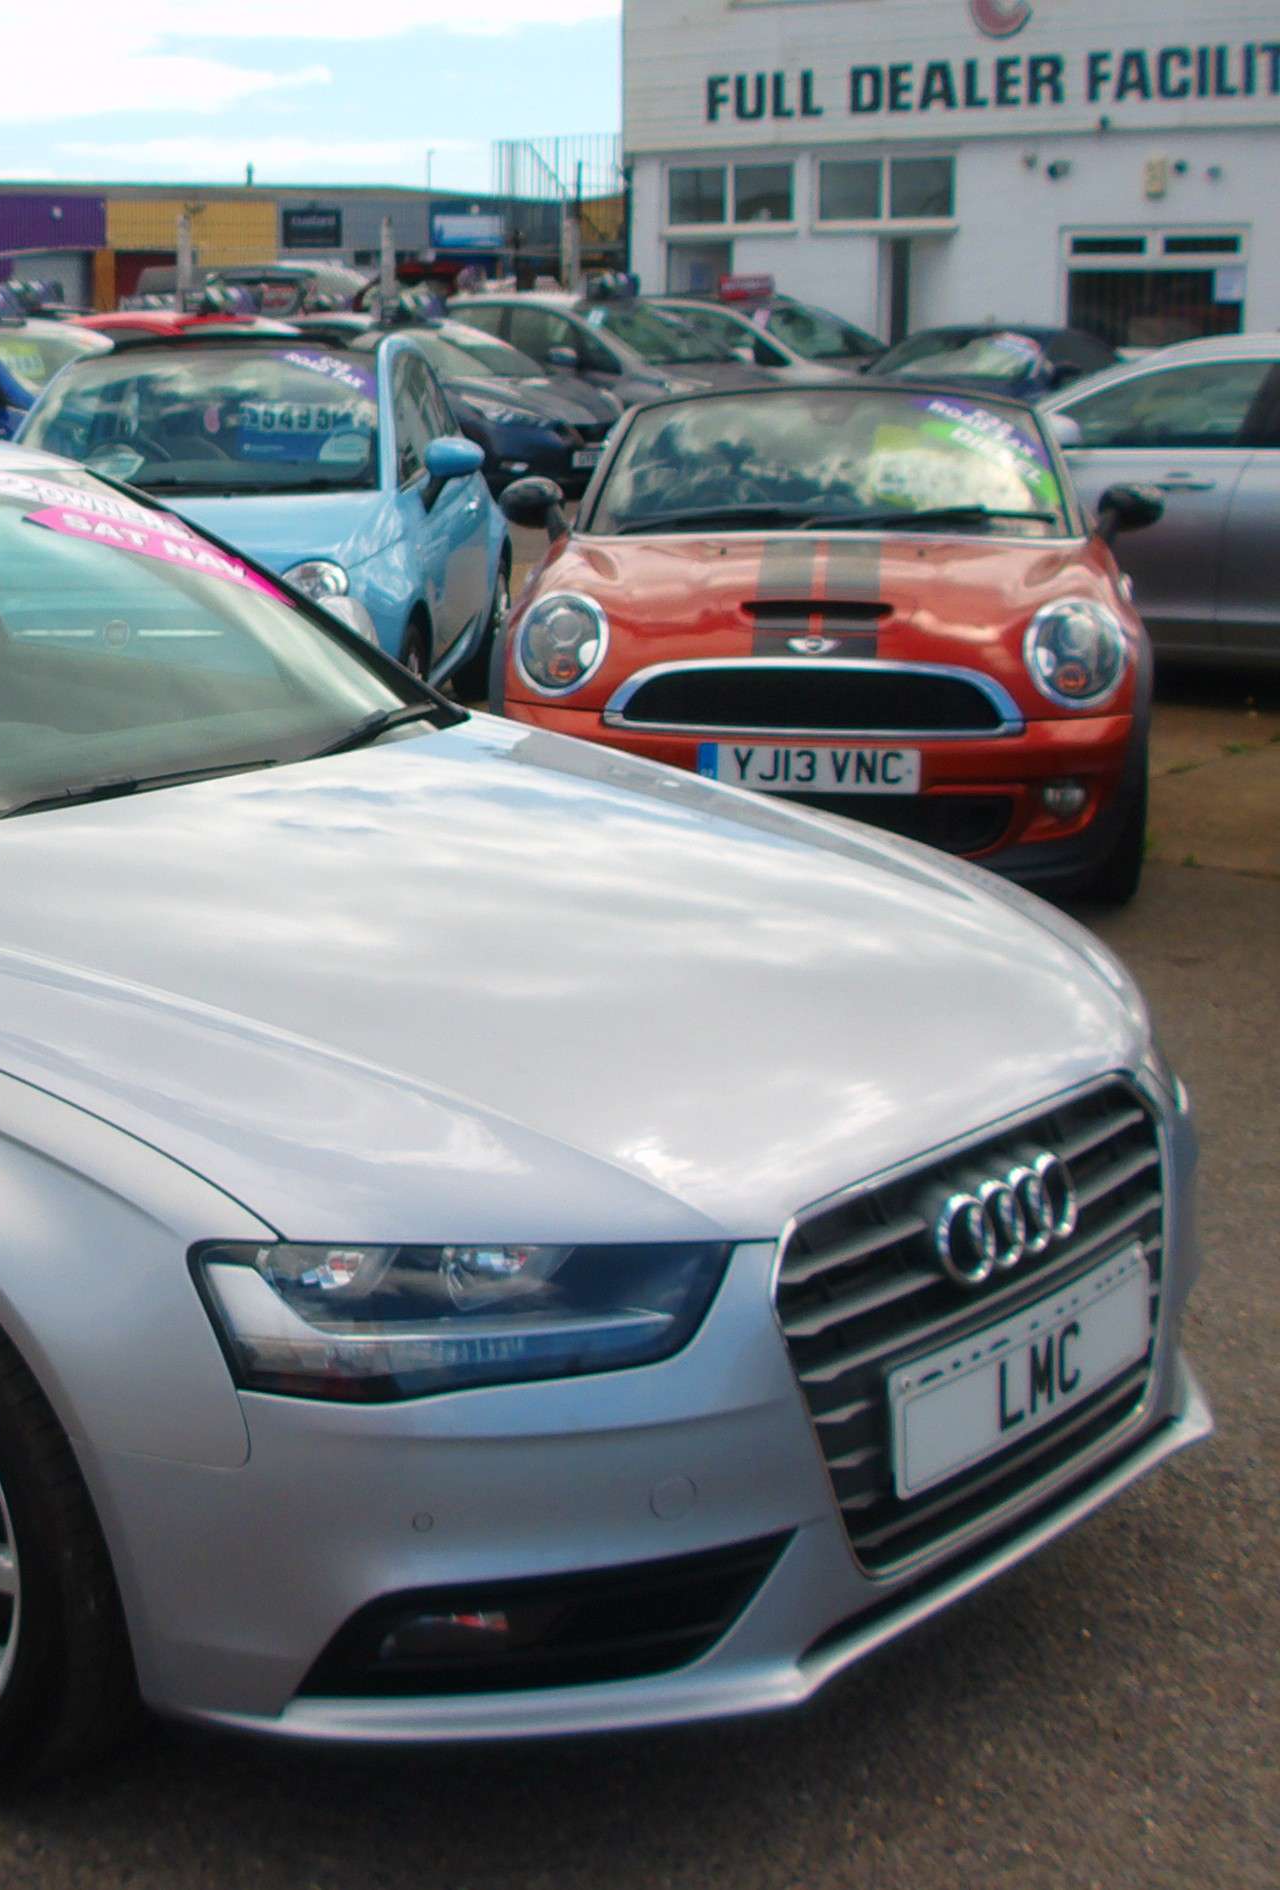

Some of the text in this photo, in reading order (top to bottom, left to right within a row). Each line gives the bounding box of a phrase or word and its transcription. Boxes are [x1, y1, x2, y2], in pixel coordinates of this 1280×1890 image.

[706, 67, 823, 122] FULL
[849, 53, 1065, 114] DEALER
[61, 512, 247, 580] SAT NAV
[732, 746, 904, 785] YJ13 VNC
[998, 1321, 1080, 1433] LMC
